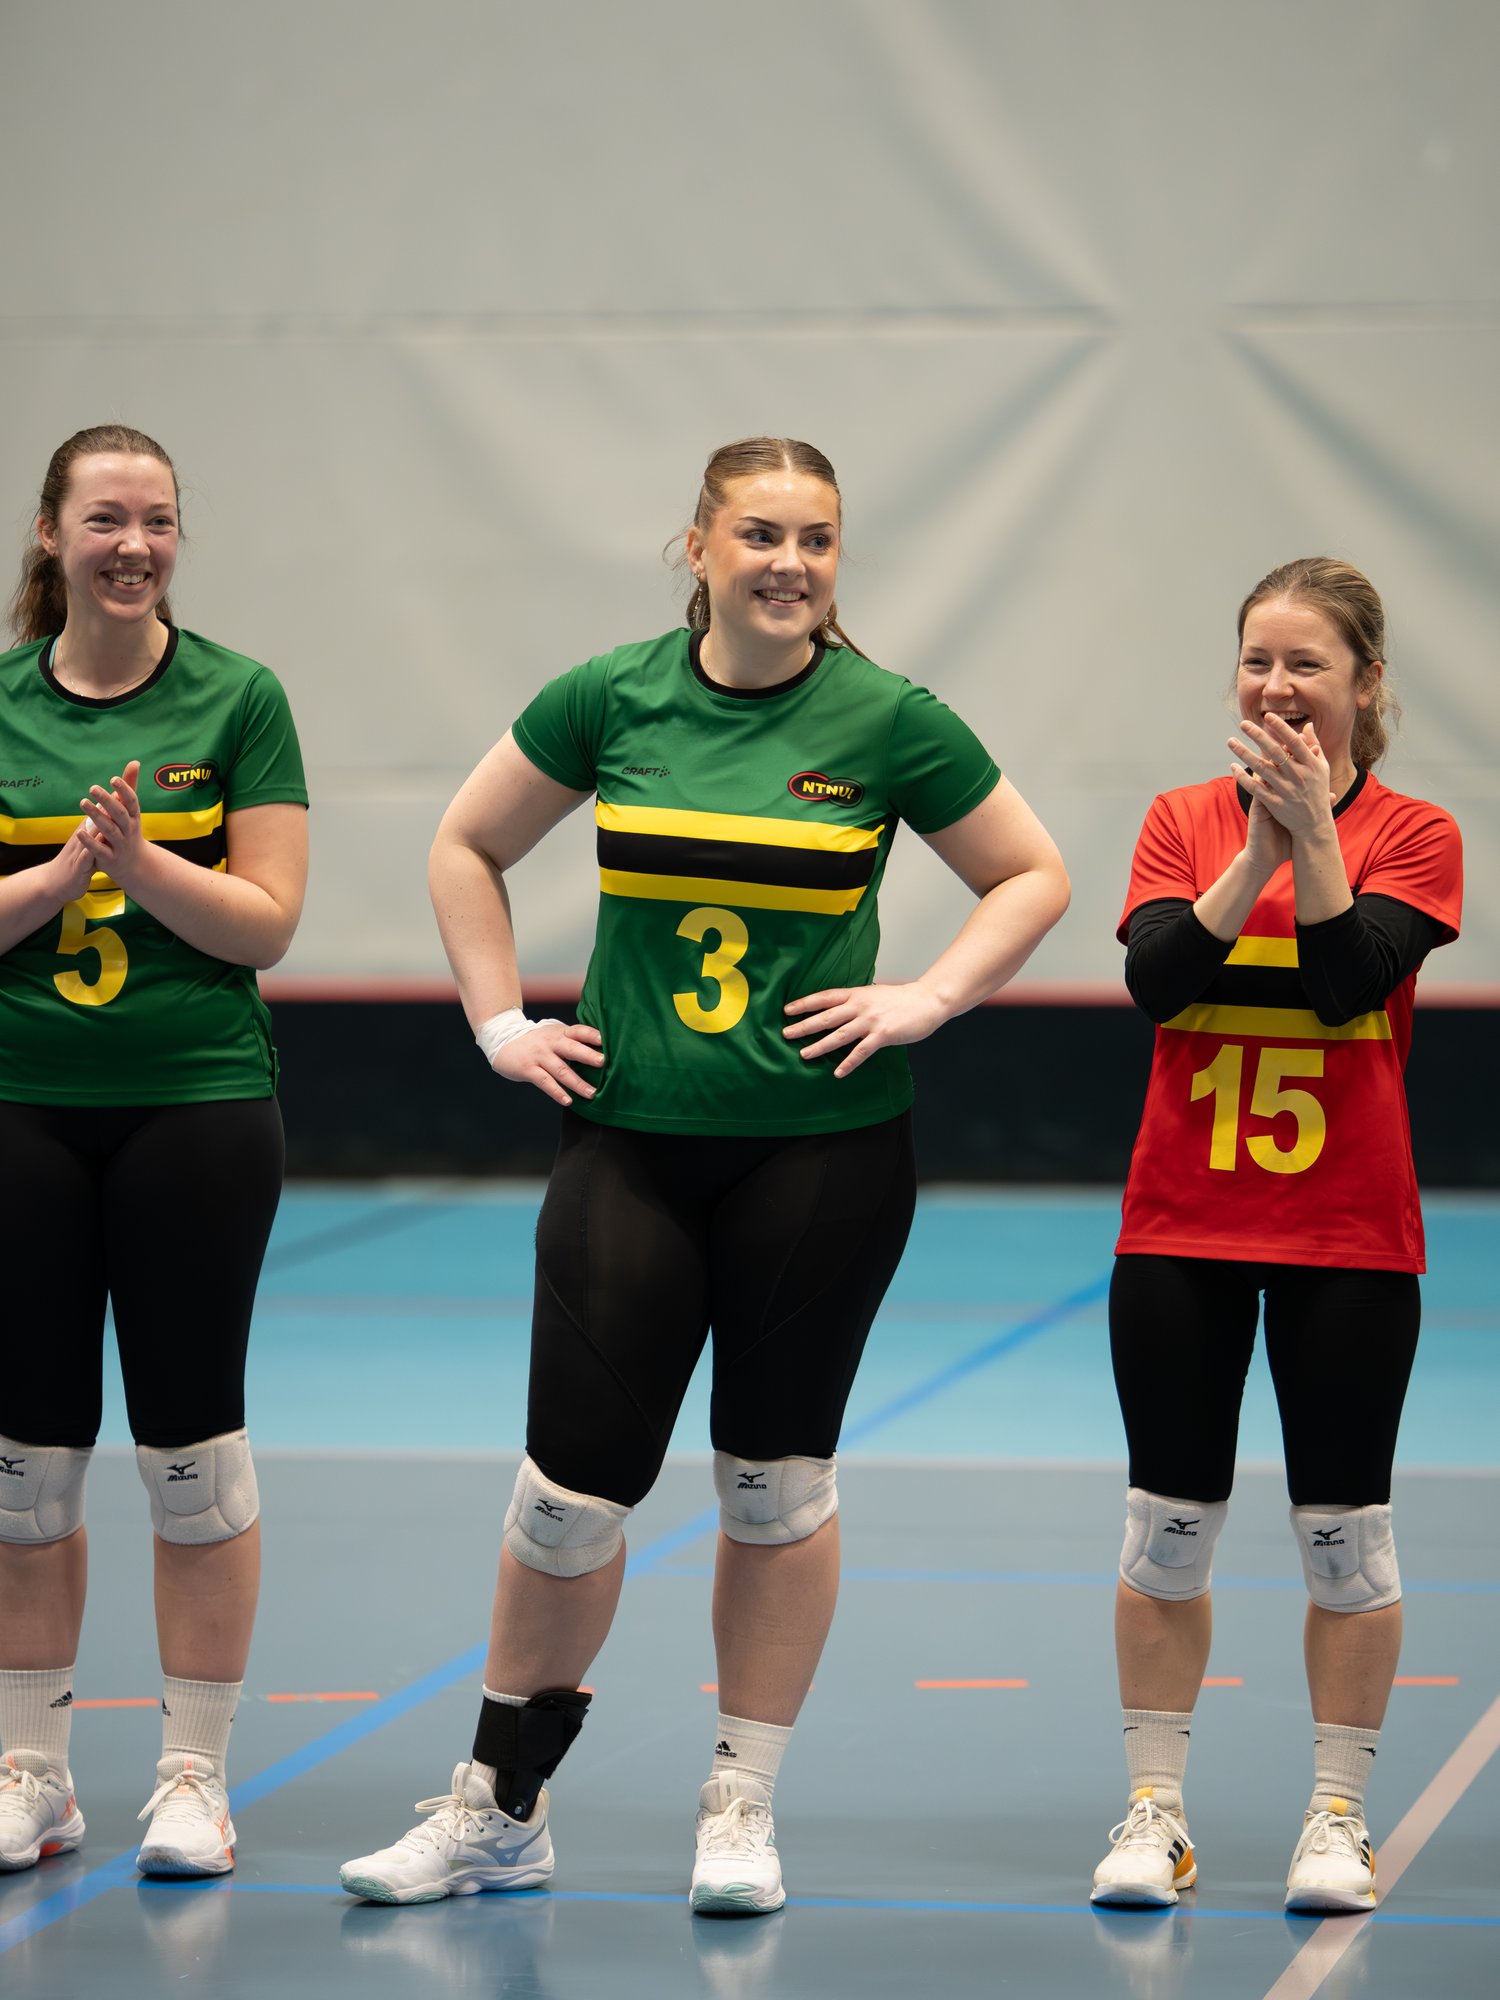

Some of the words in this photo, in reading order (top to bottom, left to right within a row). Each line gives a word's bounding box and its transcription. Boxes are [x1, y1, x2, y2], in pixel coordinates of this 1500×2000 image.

[0, 778, 33, 788] RAFT
[621, 766, 660, 776] CRAFT
[53, 890, 129, 1007] 5
[672, 906, 750, 1034] 3
[1190, 1043, 1327, 1175] 15
